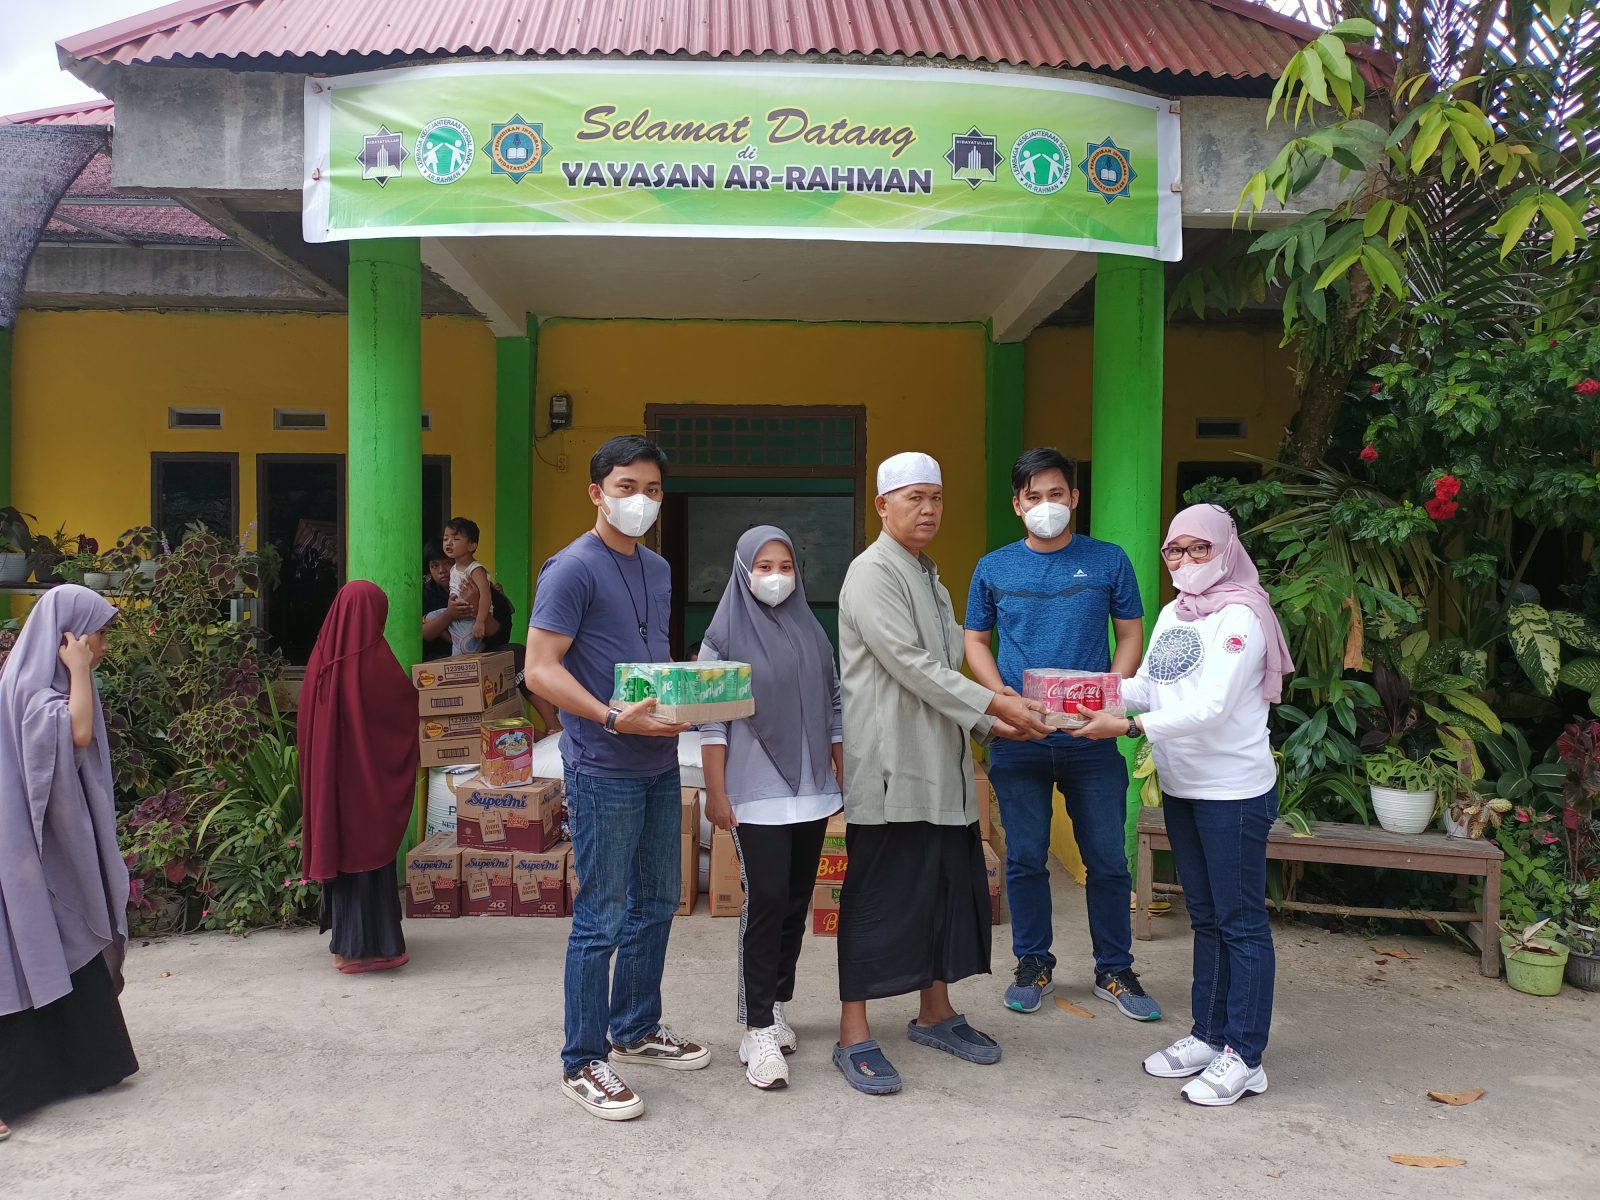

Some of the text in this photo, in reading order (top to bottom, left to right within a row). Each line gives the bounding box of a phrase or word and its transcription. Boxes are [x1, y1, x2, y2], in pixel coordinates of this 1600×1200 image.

[576, 104, 916, 158] Selamat Datang
[737, 145, 757, 160] di
[426, 172, 461, 183] AR-RAHMAN
[561, 162, 932, 194] YAYASAN AR-RAHMAN
[1023, 182, 1060, 193] AR-RAHMAN
